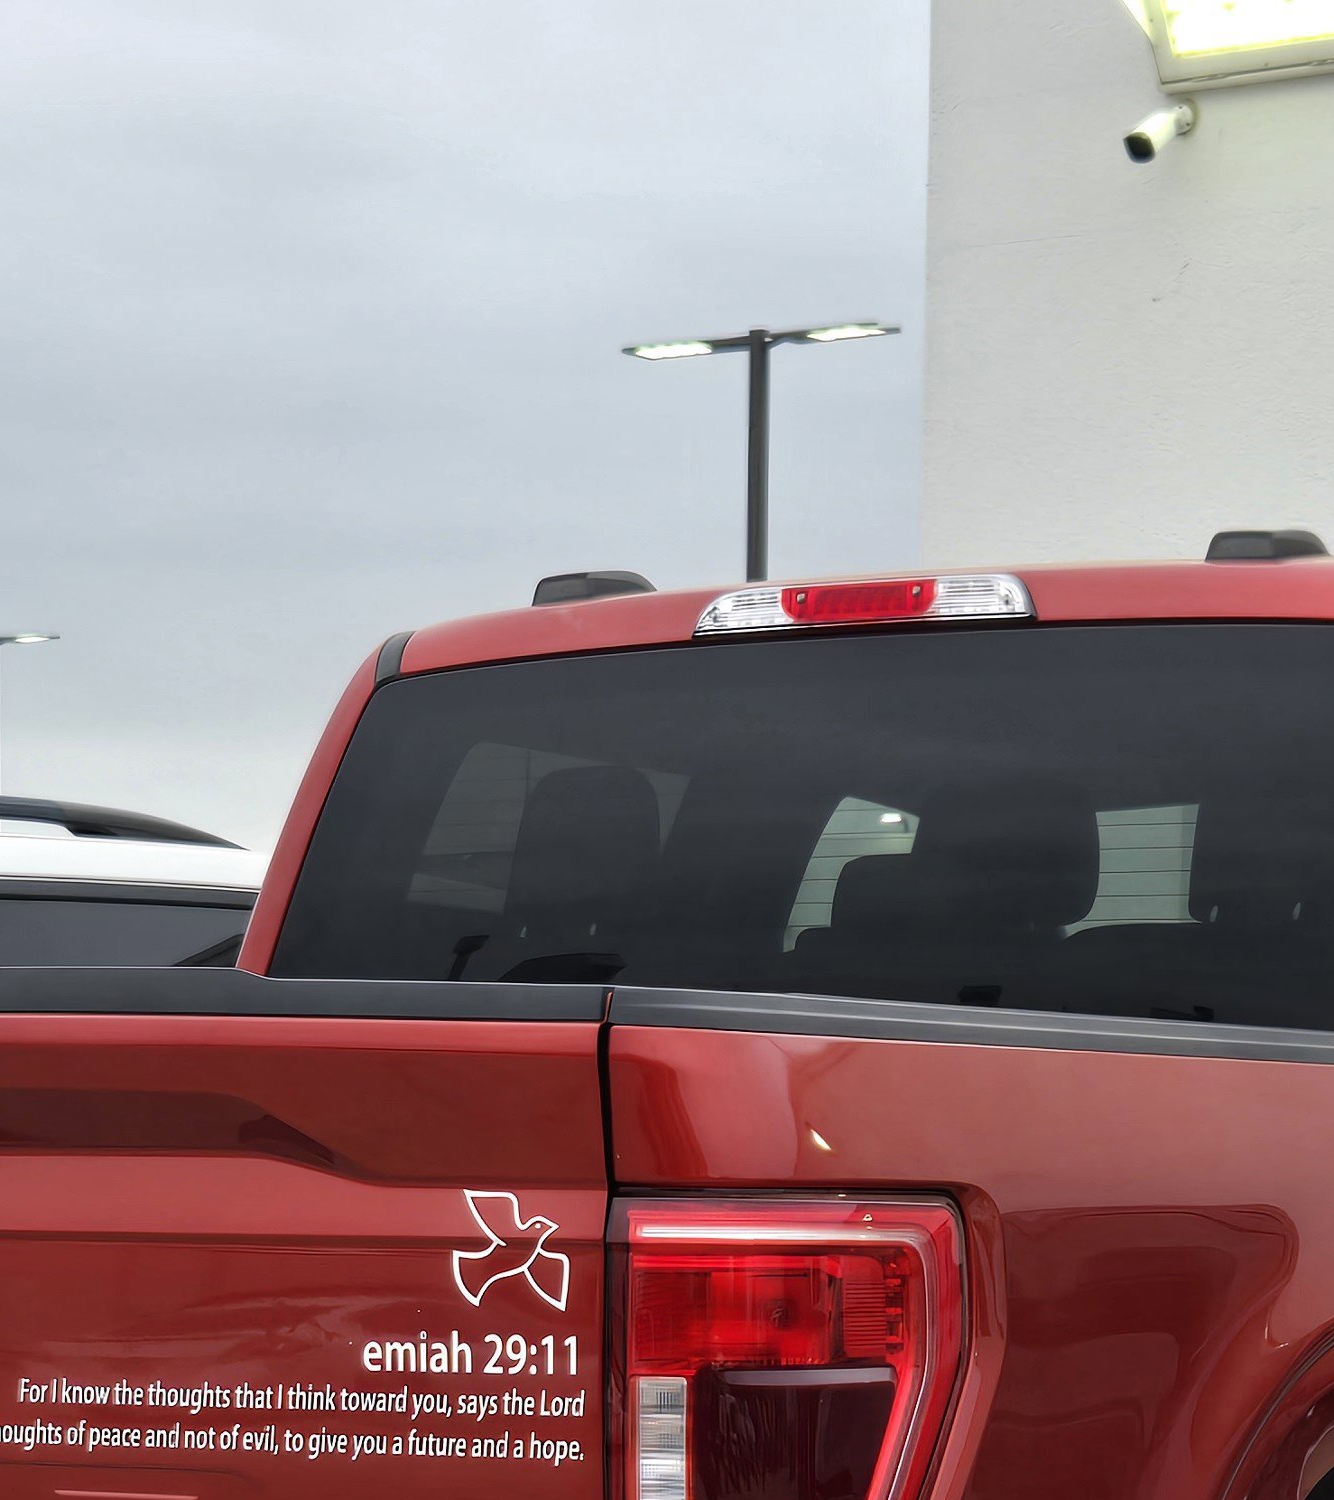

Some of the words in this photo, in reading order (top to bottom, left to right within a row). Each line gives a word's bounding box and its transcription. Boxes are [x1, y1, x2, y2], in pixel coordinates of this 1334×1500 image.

[363, 1330, 472, 1374] emiah
[483, 1333, 577, 1376] 29:11
[20, 1377, 49, 1403] For
[52, 1378, 58, 1403] I
[62, 1377, 110, 1405] know
[114, 1379, 144, 1406] the
[147, 1380, 231, 1415] thoughts
[234, 1381, 274, 1410] that
[277, 1383, 283, 1410] I
[287, 1382, 336, 1411] think
[340, 1385, 408, 1413] toward
[411, 1393, 452, 1421] you,
[457, 1394, 498, 1422] says
[502, 1387, 535, 1416] the
[539, 1389, 585, 1417] Lord
[66, 1419, 87, 1446] of
[88, 1427, 141, 1452] peace
[144, 1421, 180, 1449] and
[184, 1426, 217, 1450] not
[219, 1424, 241, 1451] of
[242, 1425, 279, 1455] evil,
[283, 1429, 304, 1453] to
[308, 1426, 348, 1460] give
[351, 1434, 387, 1461] you
[391, 1436, 403, 1455] a
[407, 1428, 467, 1457] future
[471, 1430, 509, 1459] and
[512, 1439, 524, 1459] a
[529, 1431, 584, 1467] hope.
